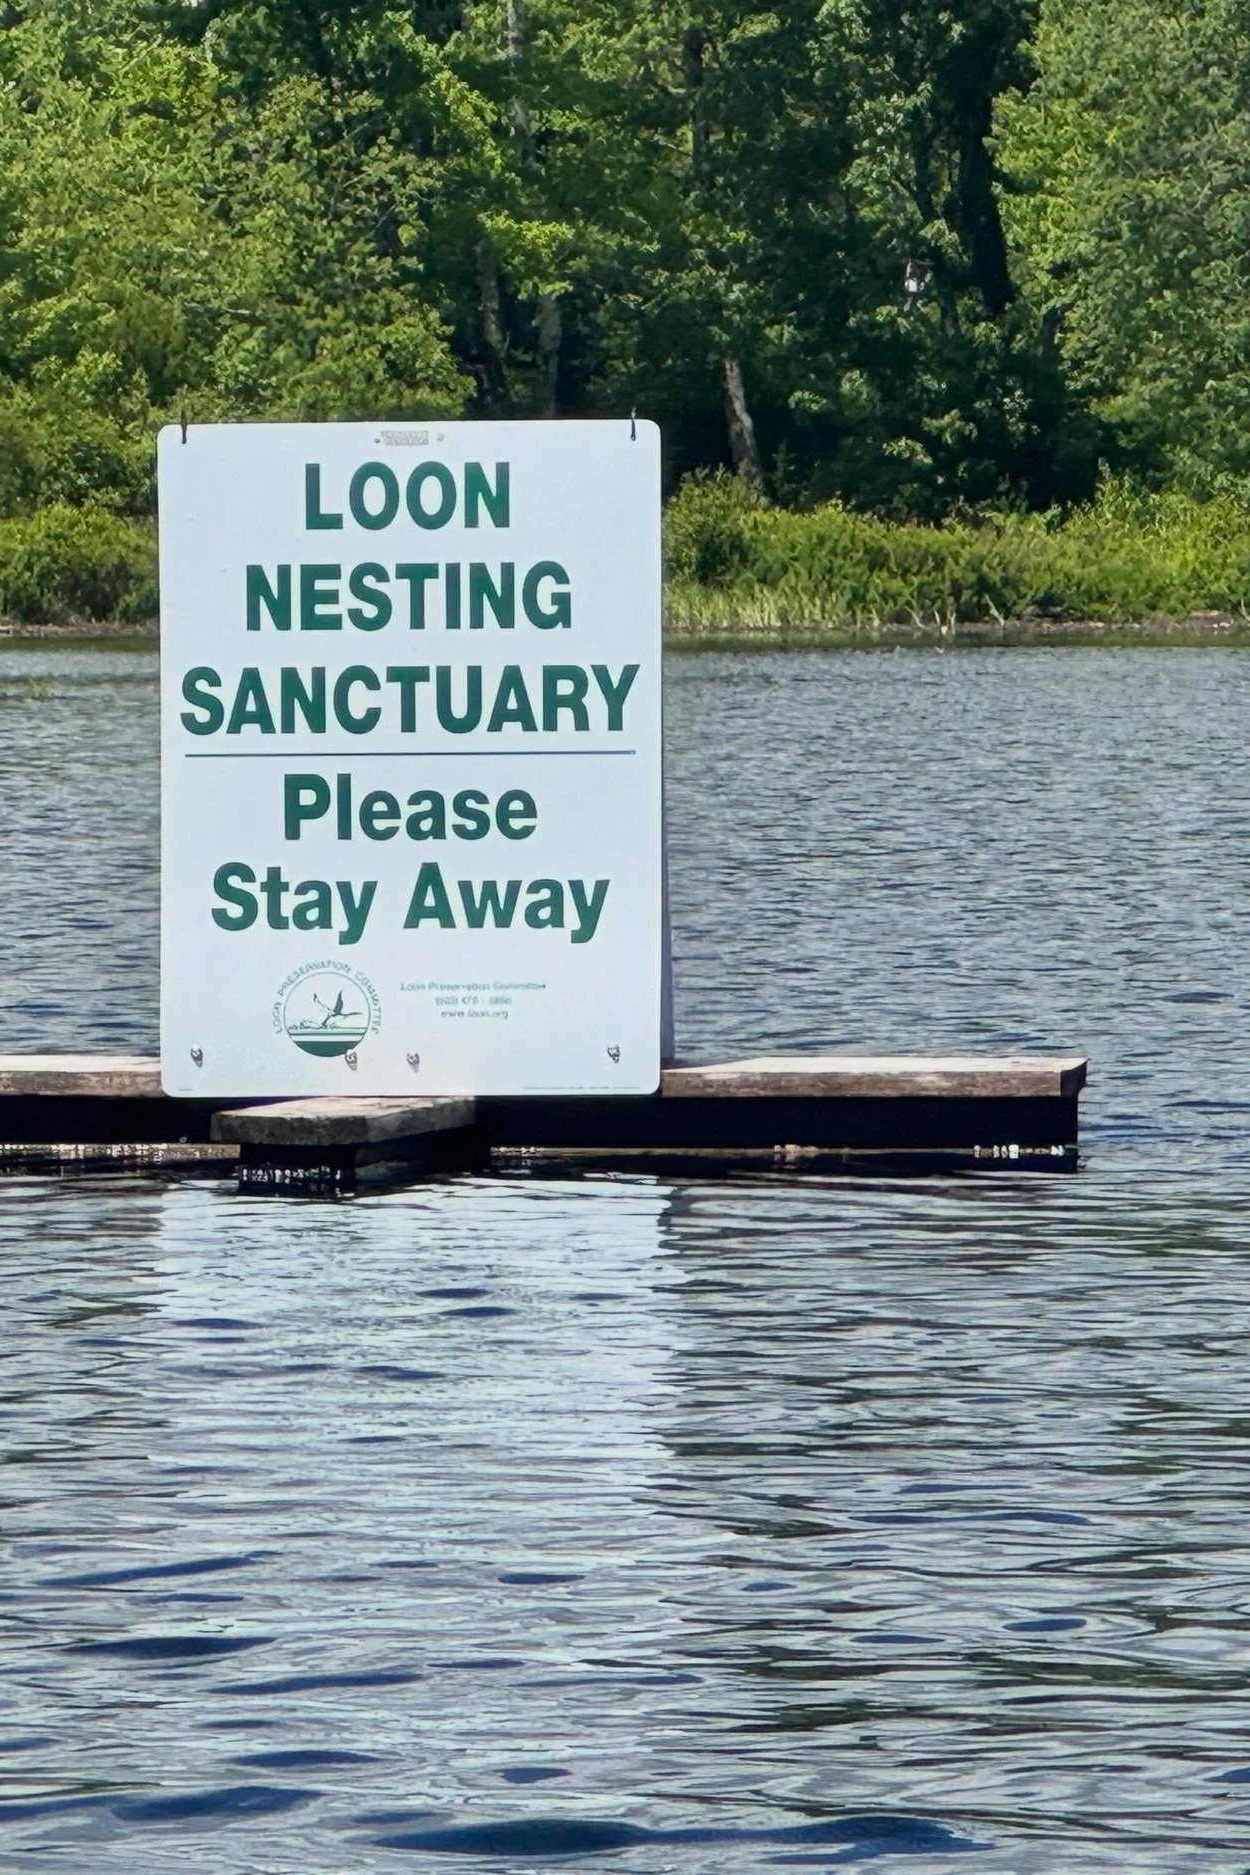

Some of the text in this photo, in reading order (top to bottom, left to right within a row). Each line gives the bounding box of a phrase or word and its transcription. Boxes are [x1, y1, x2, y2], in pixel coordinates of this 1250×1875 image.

[306, 461, 509, 530] LOON
[246, 561, 571, 631] NESTING
[181, 664, 640, 735] SANCTUARY
[284, 774, 537, 841] Please
[212, 862, 609, 945] Stay Away
